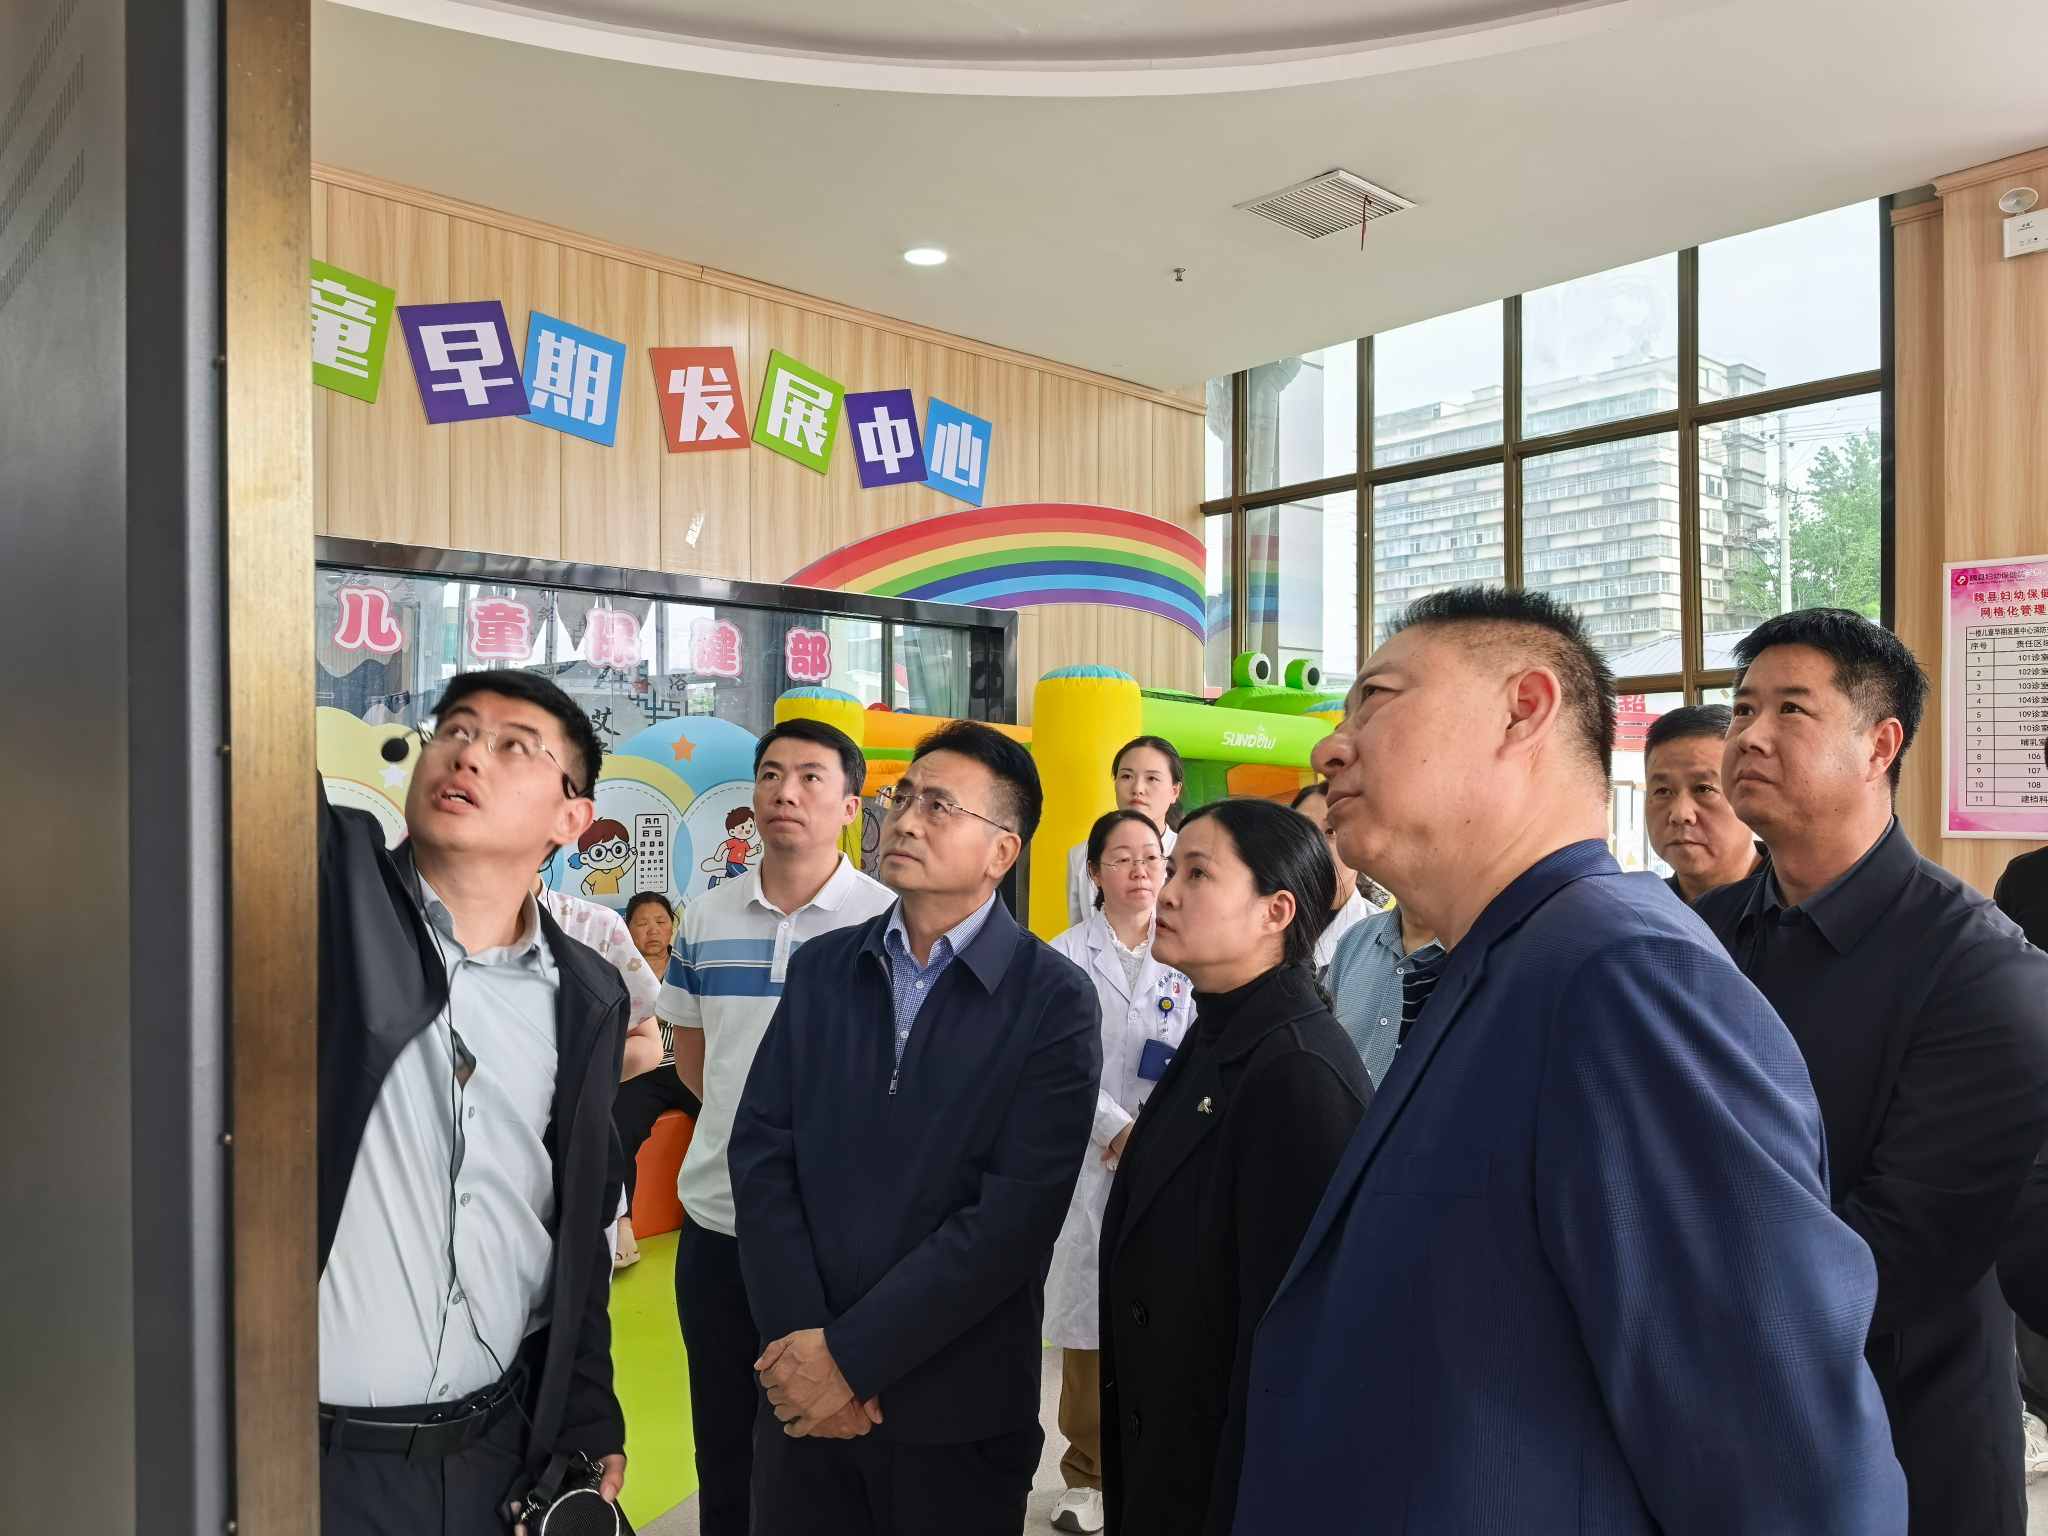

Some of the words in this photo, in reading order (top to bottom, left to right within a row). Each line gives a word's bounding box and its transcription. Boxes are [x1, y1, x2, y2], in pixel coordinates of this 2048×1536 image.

[312, 278, 983, 488] 童早期发展中心
[335, 586, 831, 681] 儿童保健部
[1968, 626, 2048, 637] 一楼儿童早期发展中心消防
[1970, 642, 1987, 650] 序号
[2027, 752, 2042, 760] 106
[2027, 781, 2042, 789] 108
